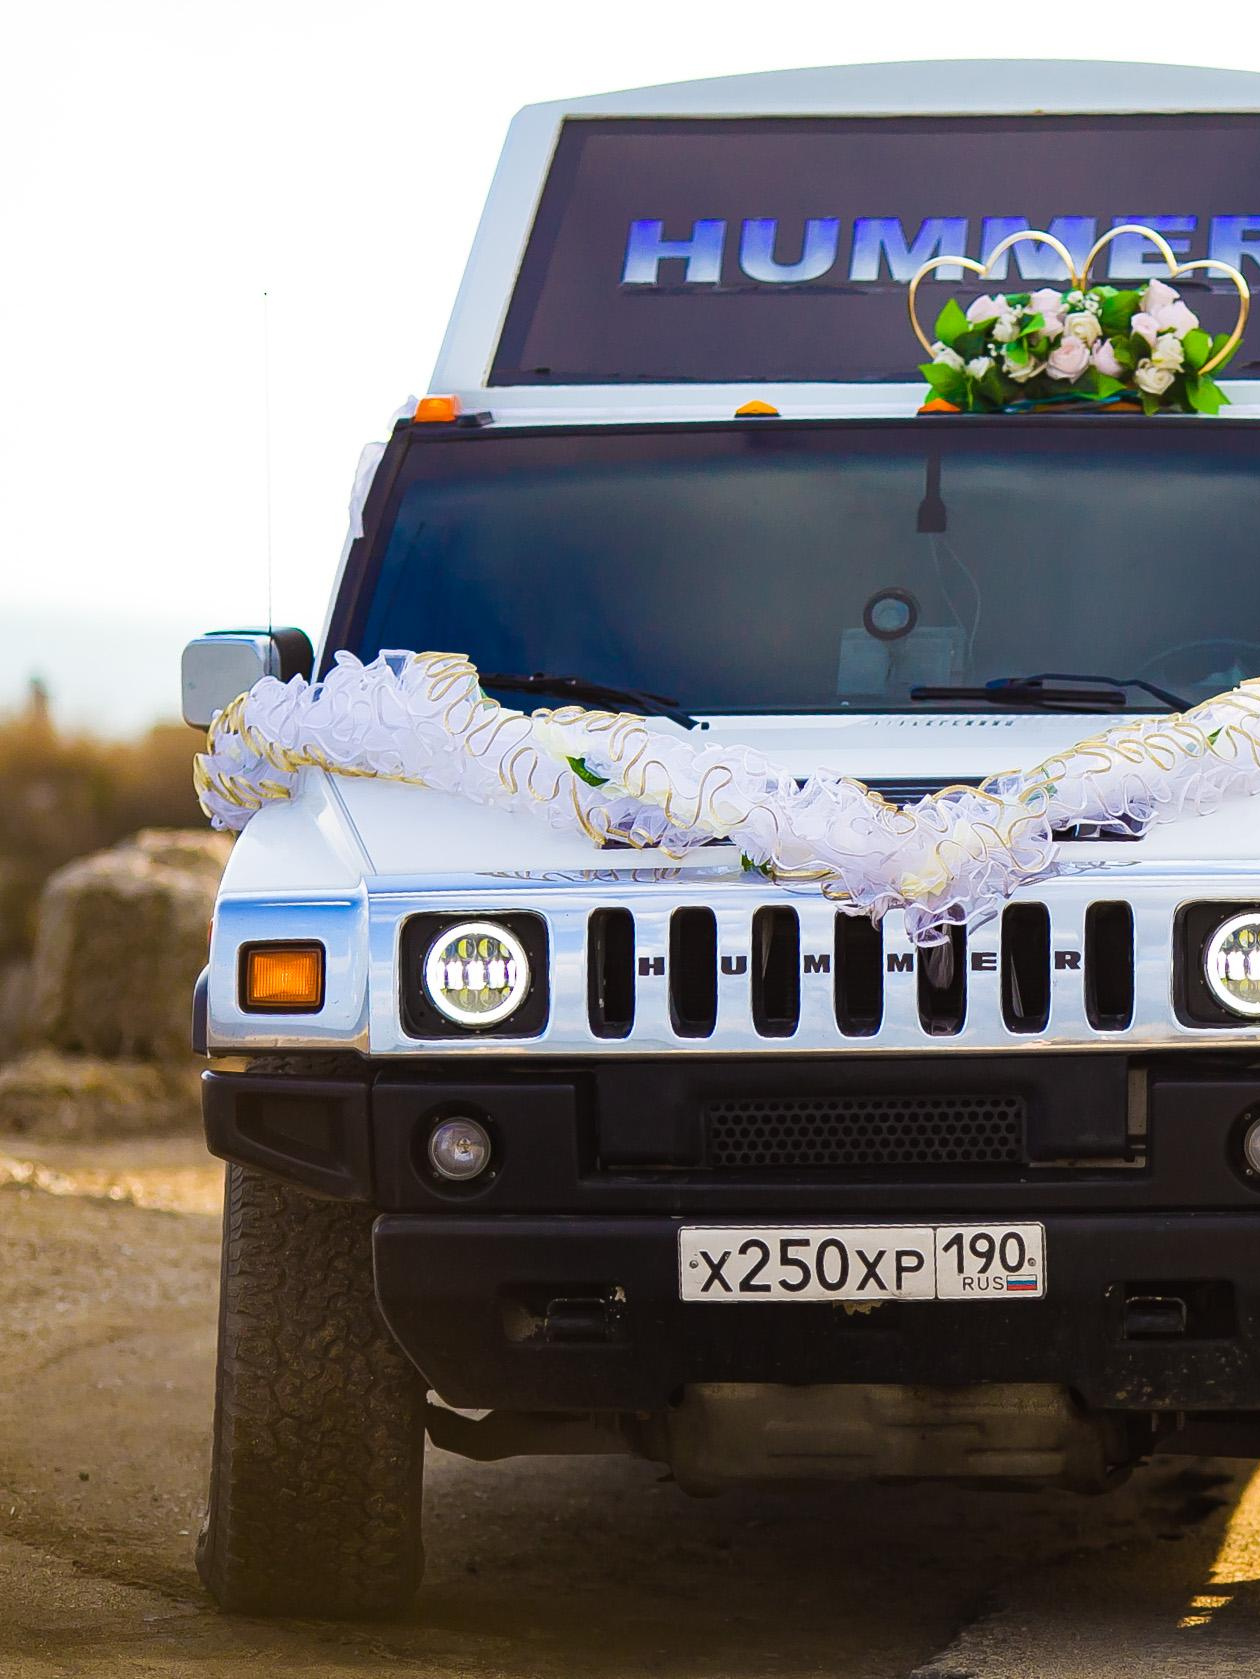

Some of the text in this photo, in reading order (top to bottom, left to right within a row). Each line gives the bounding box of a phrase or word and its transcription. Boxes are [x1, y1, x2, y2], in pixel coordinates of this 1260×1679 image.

[638, 949, 1082, 977] HUMMER
[941, 1231, 1025, 1274] 190
[962, 1276, 1004, 1291] RUS
